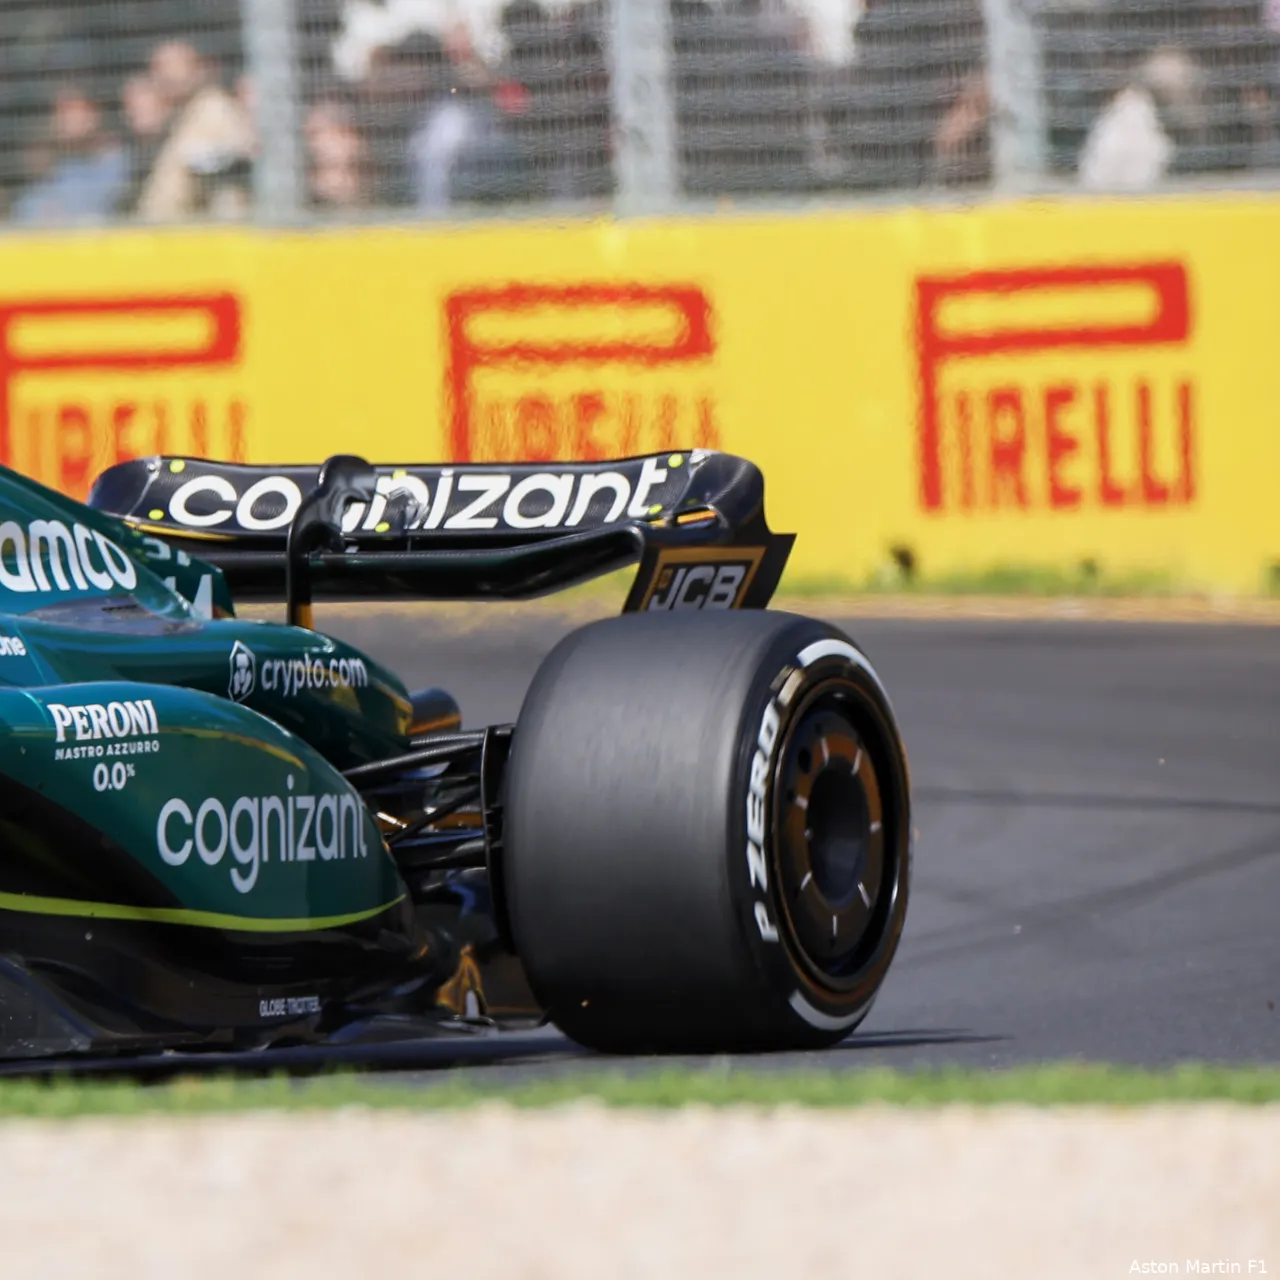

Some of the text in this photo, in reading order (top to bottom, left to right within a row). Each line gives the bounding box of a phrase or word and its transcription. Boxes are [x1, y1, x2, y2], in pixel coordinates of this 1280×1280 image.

[916, 260, 1196, 514] PIRELLI
[169, 457, 670, 534] conizant
[648, 565, 746, 610] JCB
[260, 652, 368, 697] crypto.com
[47, 699, 159, 743] PERONI
[55, 739, 160, 761] NASTRO AZZURRO
[93, 761, 136, 792] 0.0%
[746, 697, 780, 893] ZERO
[157, 774, 368, 894] cognizant
